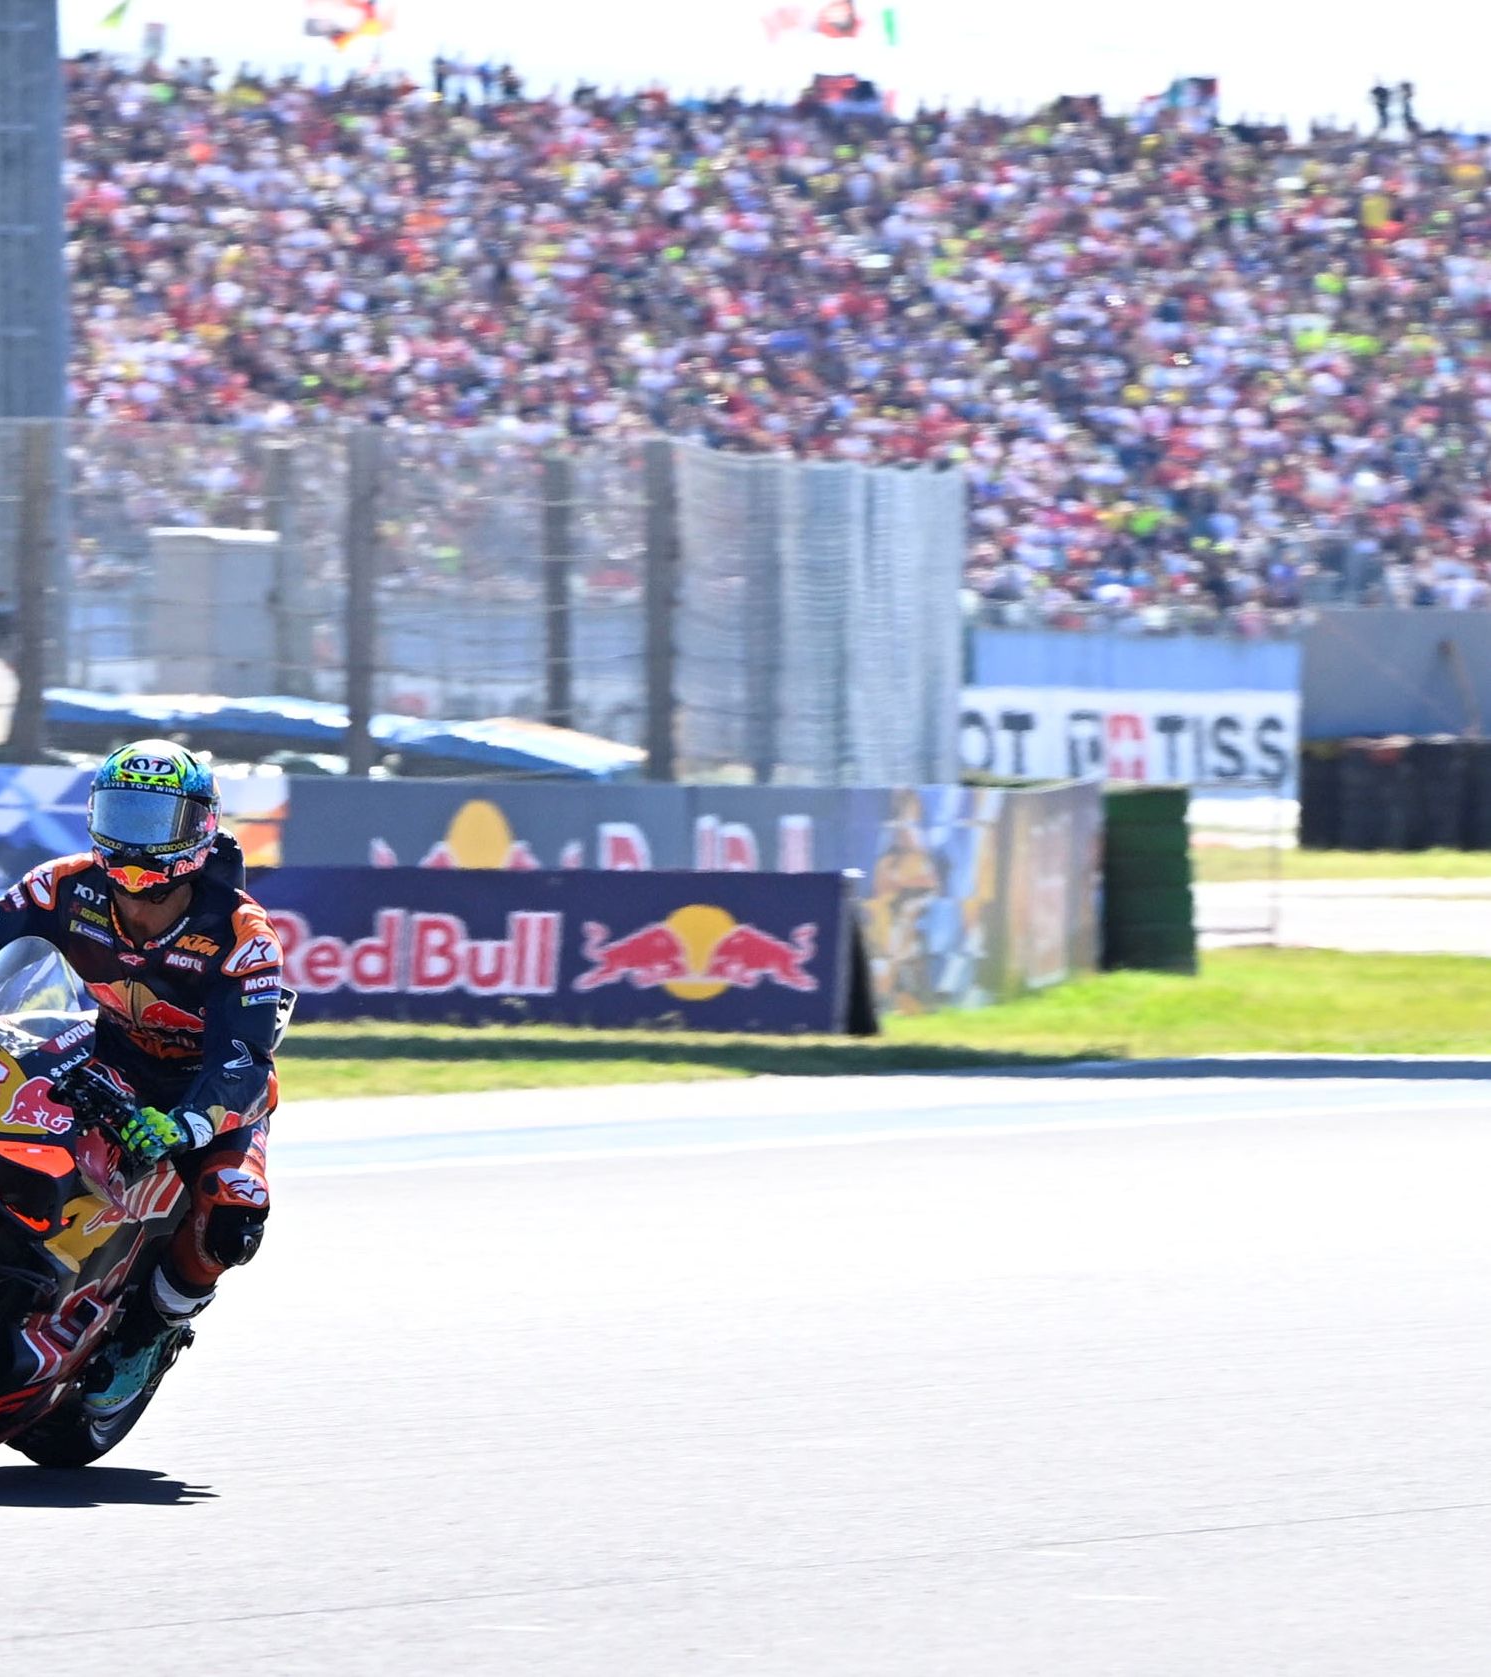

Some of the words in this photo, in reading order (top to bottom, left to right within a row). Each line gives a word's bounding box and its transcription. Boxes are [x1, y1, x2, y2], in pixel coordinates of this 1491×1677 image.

[125, 758, 170, 773] KYT
[156, 786, 188, 796] WINGS
[74, 883, 107, 905] KYT
[174, 935, 221, 957] KTM
[267, 909, 406, 995] Red
[409, 911, 562, 997] Bull
[55, 1021, 95, 1050] MOTUL
[60, 1047, 90, 1072] BAJAJ
